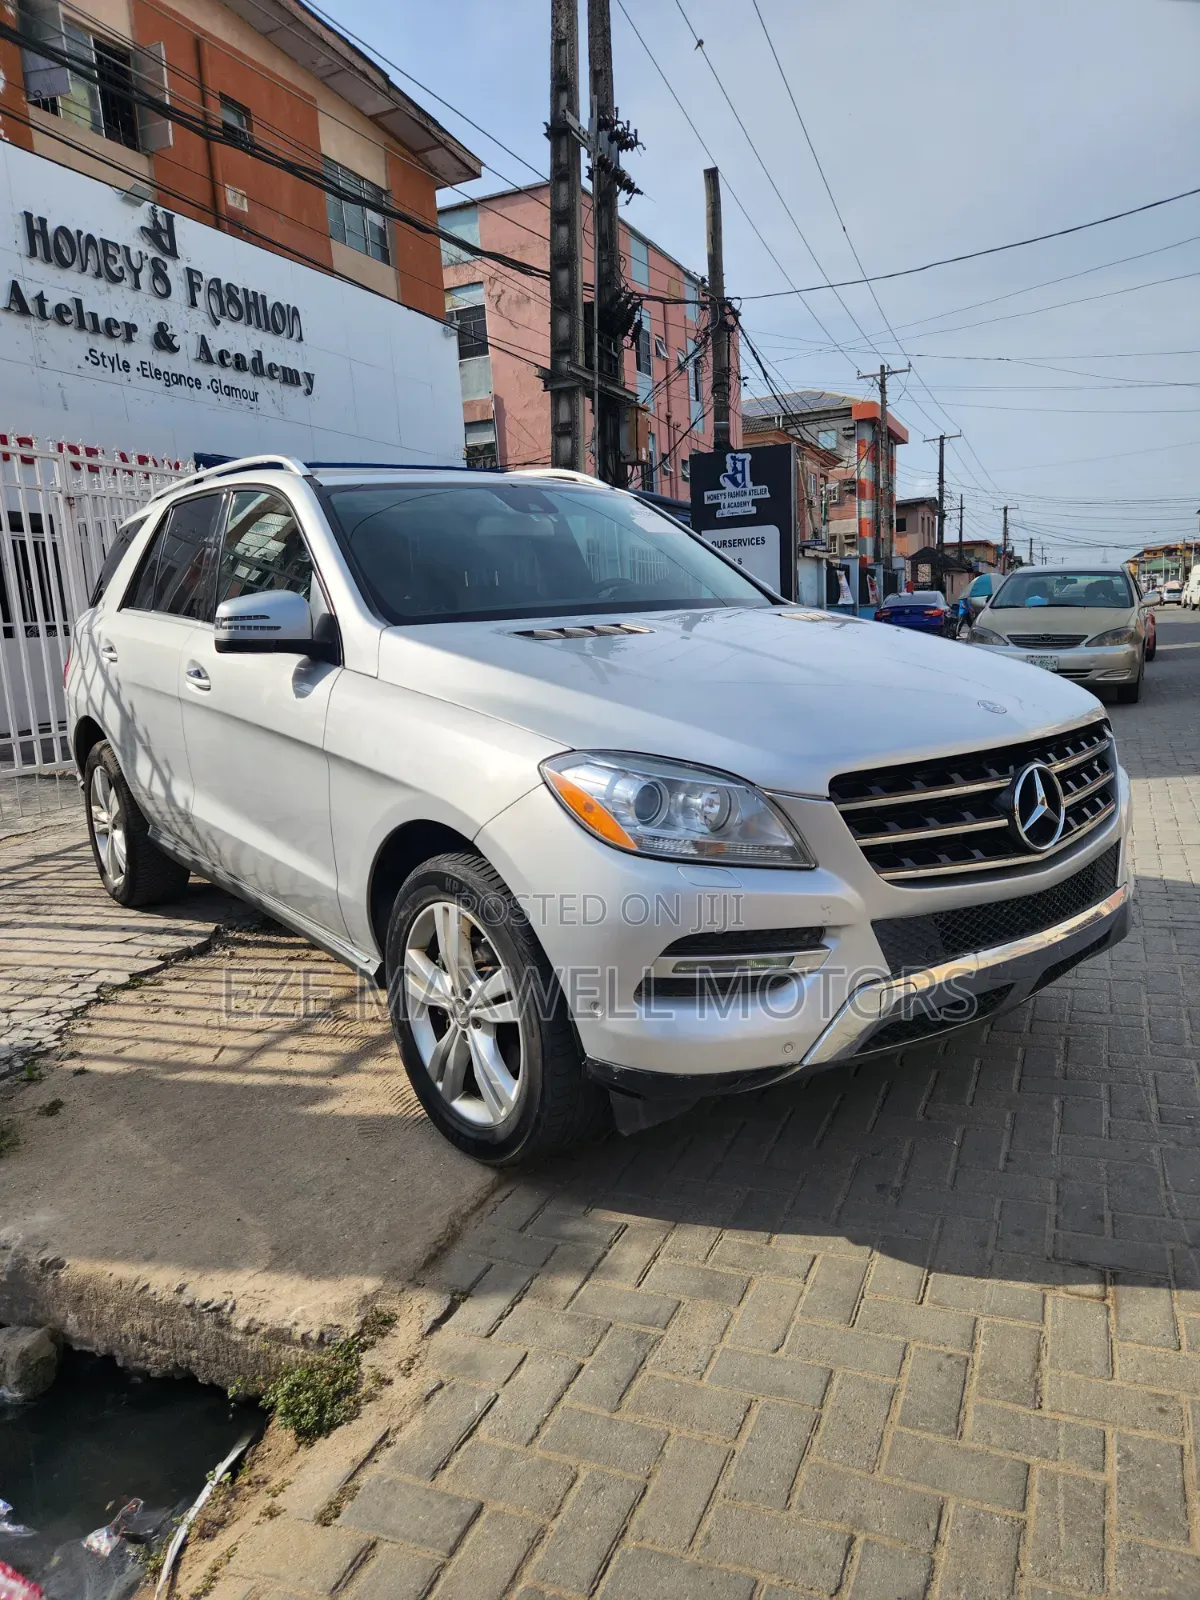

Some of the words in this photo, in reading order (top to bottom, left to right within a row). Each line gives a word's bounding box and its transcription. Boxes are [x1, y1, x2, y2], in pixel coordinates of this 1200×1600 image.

[23, 210, 173, 299] HONEY'S
[185, 266, 304, 342] FASHION
[152, 321, 181, 354] &
[195, 334, 316, 396] Academy
[706, 492, 727, 502] HONEY'S
[727, 490, 748, 500] FASHION
[747, 487, 768, 497] ATELIER
[727, 500, 751, 510] ACADEMY
